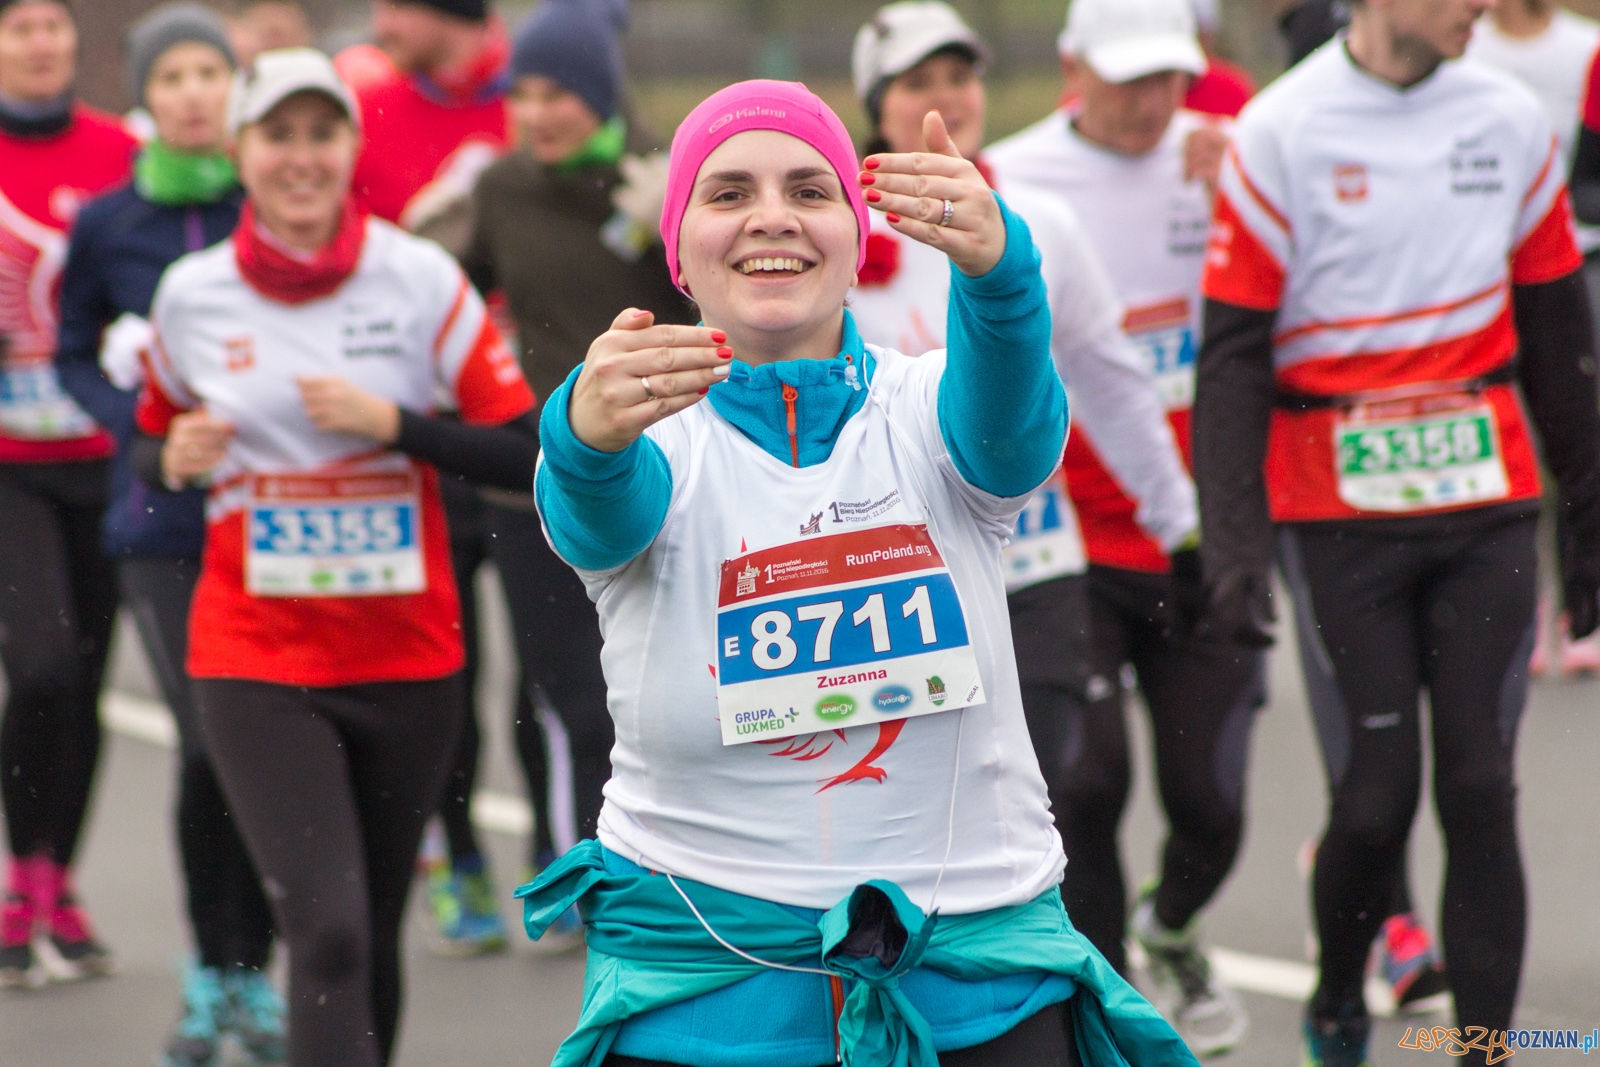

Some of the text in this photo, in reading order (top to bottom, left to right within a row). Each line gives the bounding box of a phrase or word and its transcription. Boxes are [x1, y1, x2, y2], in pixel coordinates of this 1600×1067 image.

[1359, 421, 1480, 470] 3358
[273, 508, 400, 553] 3355
[845, 544, 932, 567] RunPoland.org
[724, 584, 938, 671] E 8711
[817, 669, 887, 689] Zuzanna
[735, 708, 776, 724] GRUPA
[736, 718, 785, 735] LUXMED
